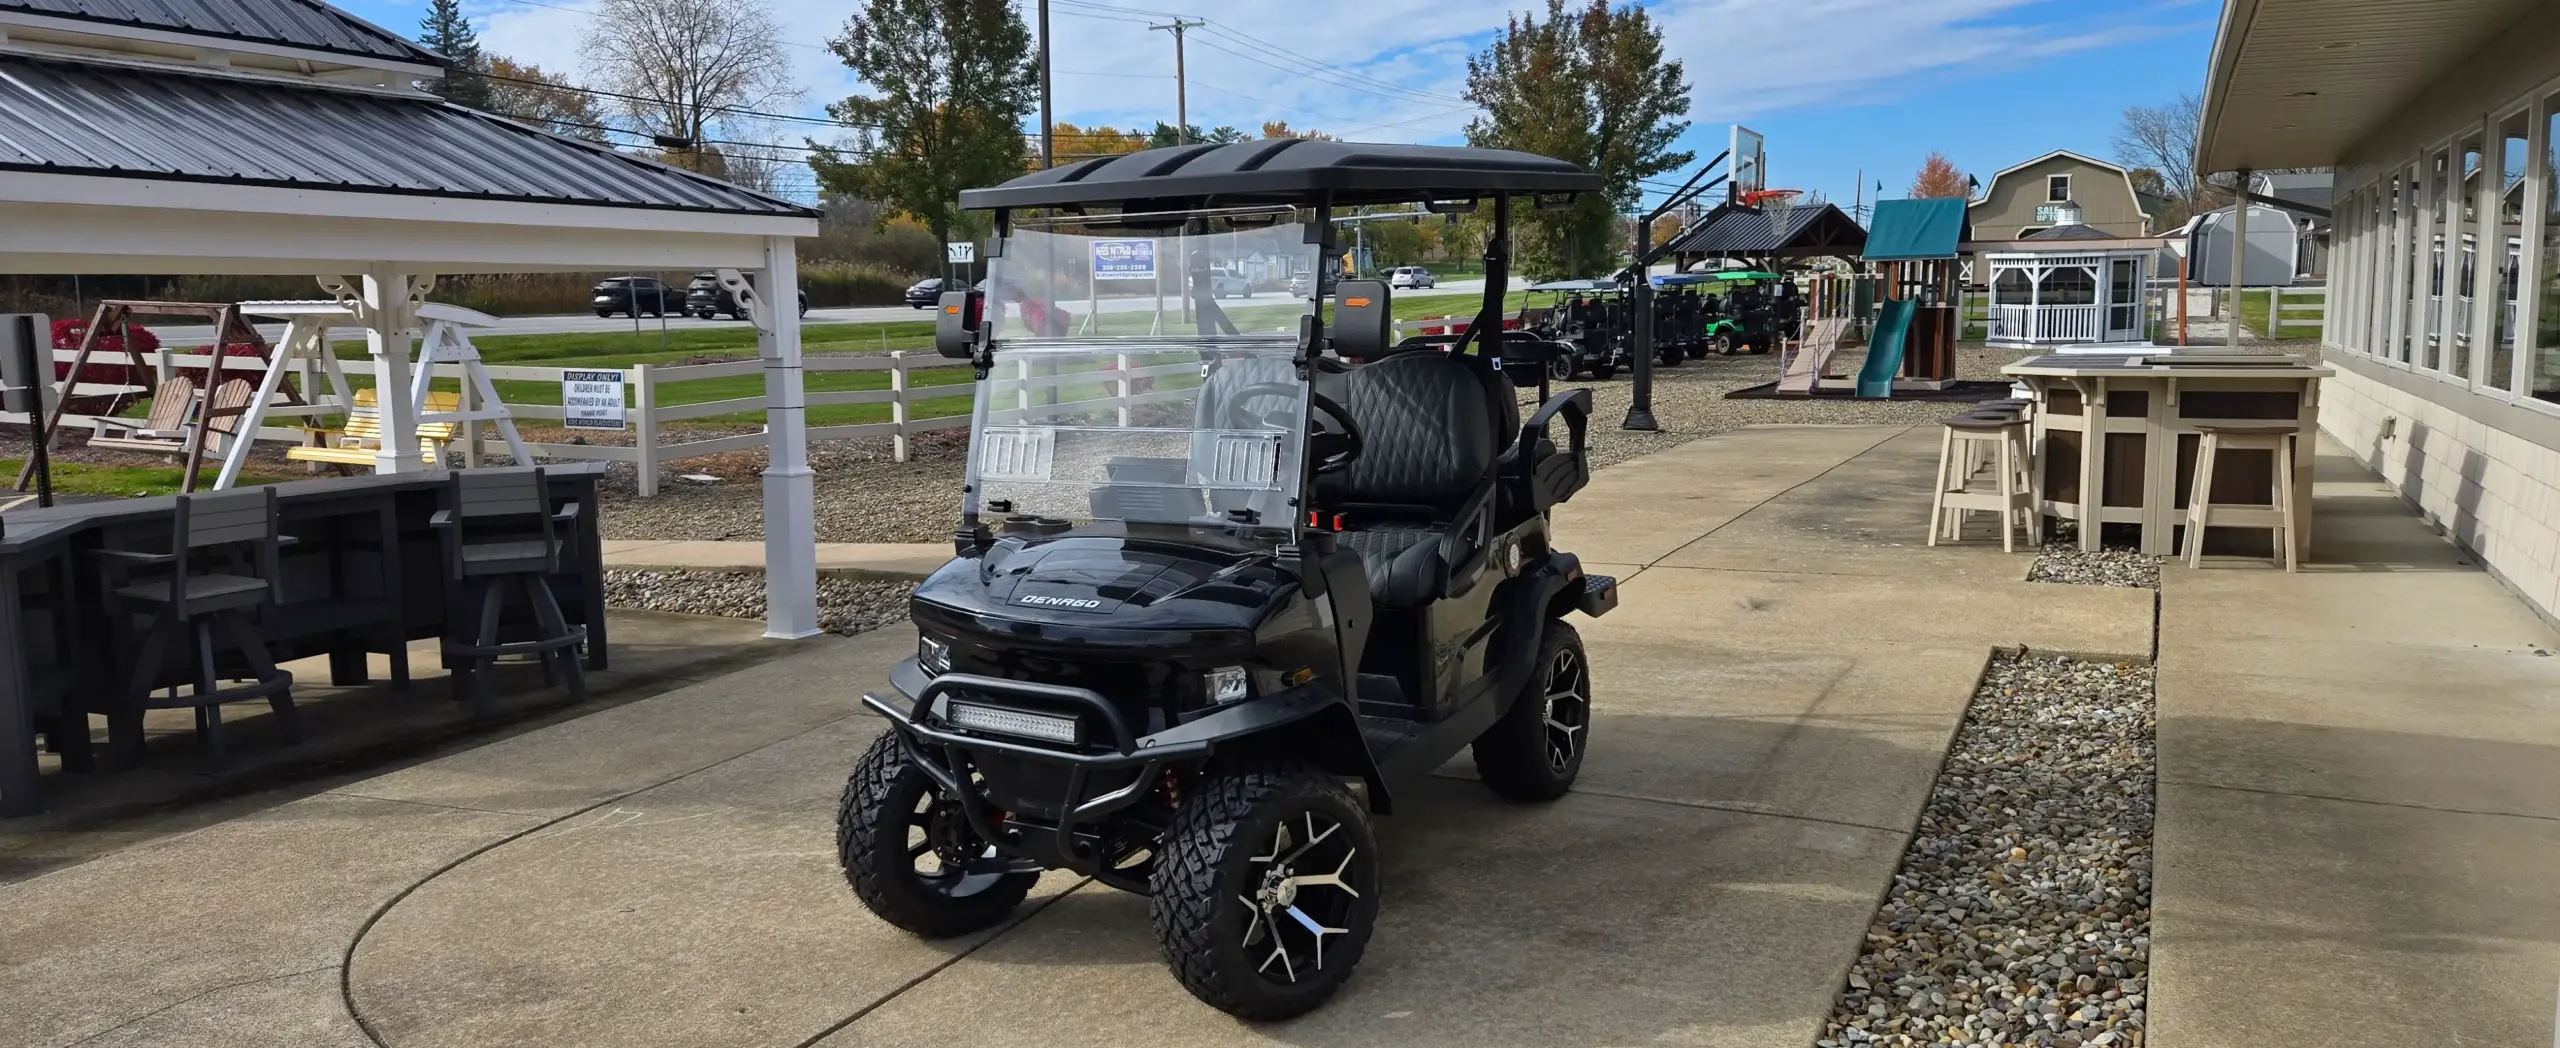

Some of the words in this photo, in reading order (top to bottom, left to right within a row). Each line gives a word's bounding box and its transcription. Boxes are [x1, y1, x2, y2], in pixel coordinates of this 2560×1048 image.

[567, 372, 596, 381] DISPLAY
[597, 373, 618, 382] ONLY!
[574, 383, 593, 393] CHILDREN
[594, 384, 604, 393] MUST
[567, 396, 594, 407] ACCOMPANIED
[608, 398, 620, 407] ADULT
[1020, 595, 1101, 608] DENAGO
